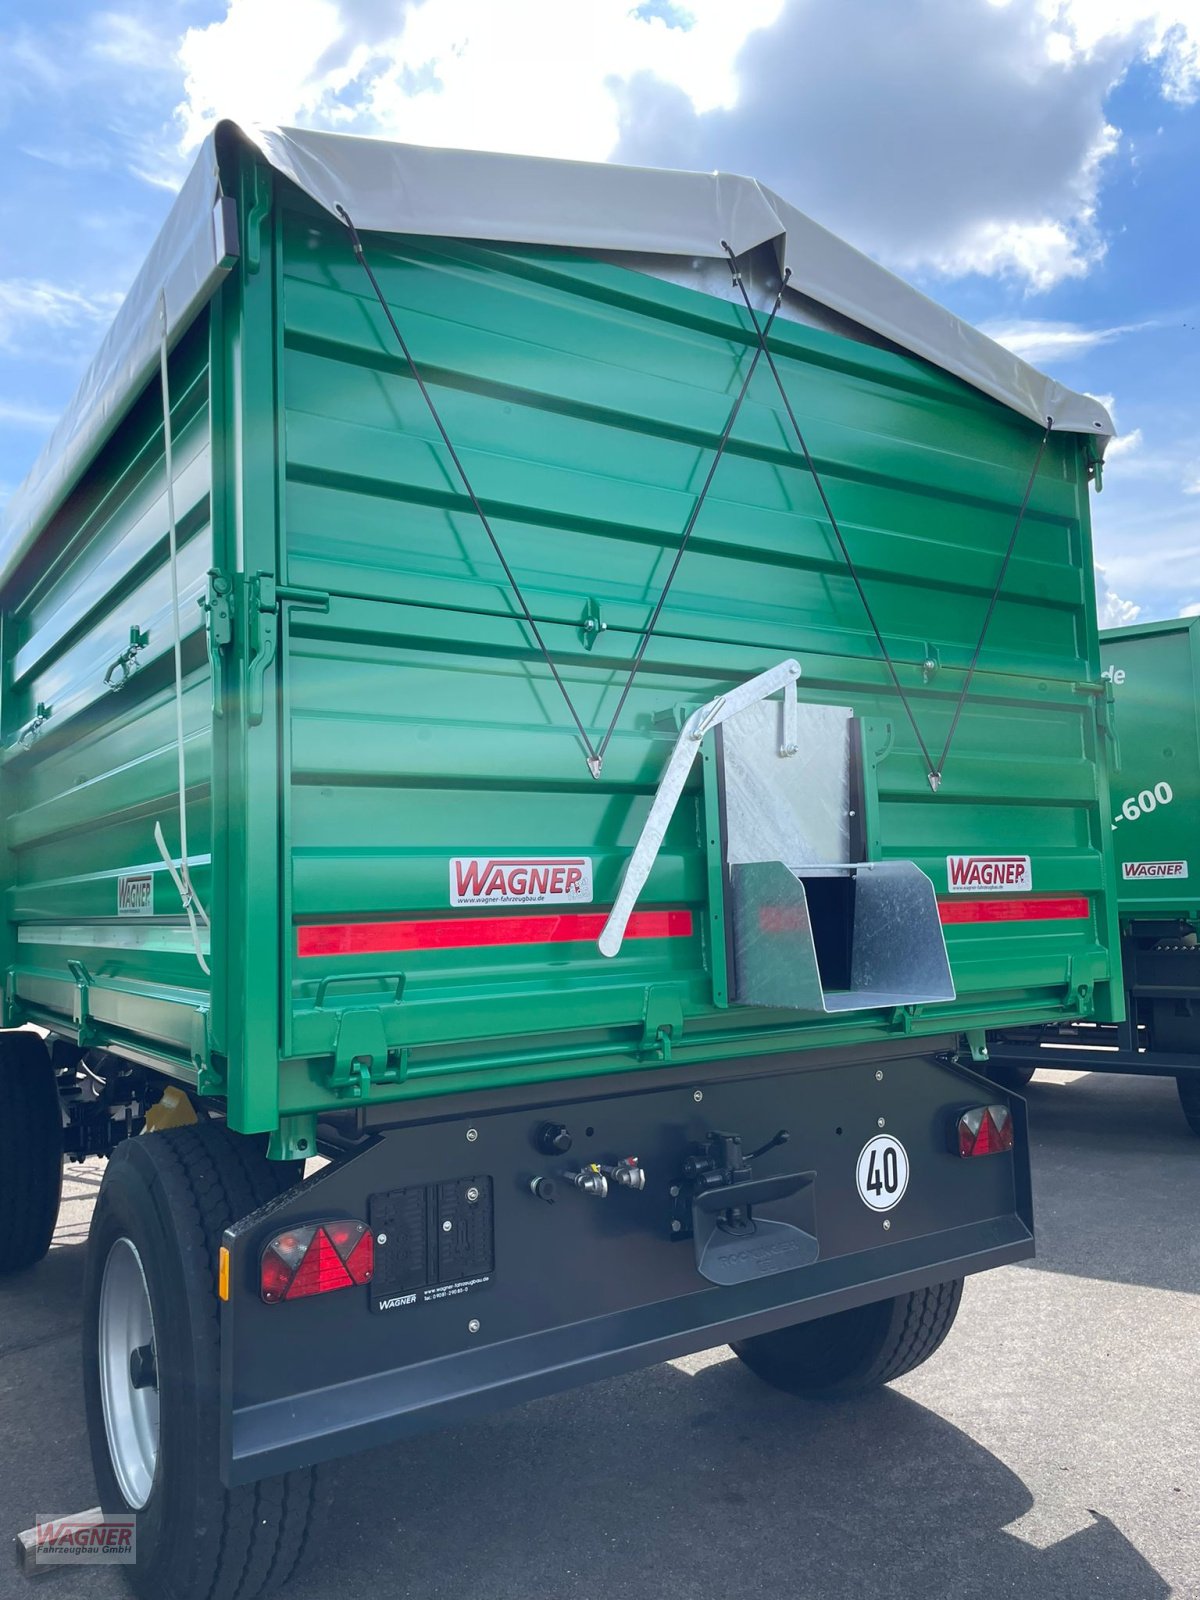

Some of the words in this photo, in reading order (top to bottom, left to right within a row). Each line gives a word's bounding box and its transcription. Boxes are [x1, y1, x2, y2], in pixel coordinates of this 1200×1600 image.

[1111, 781, 1173, 831] -600
[455, 860, 585, 896] WAGNER
[950, 857, 1026, 885] WAGNER
[1124, 861, 1184, 876] WAGNER
[119, 875, 152, 908] WAGNER
[457, 895, 545, 904] www.wagner-fahrzeugbau.de
[867, 1146, 898, 1196] 40
[379, 1293, 417, 1310] WAGNER
